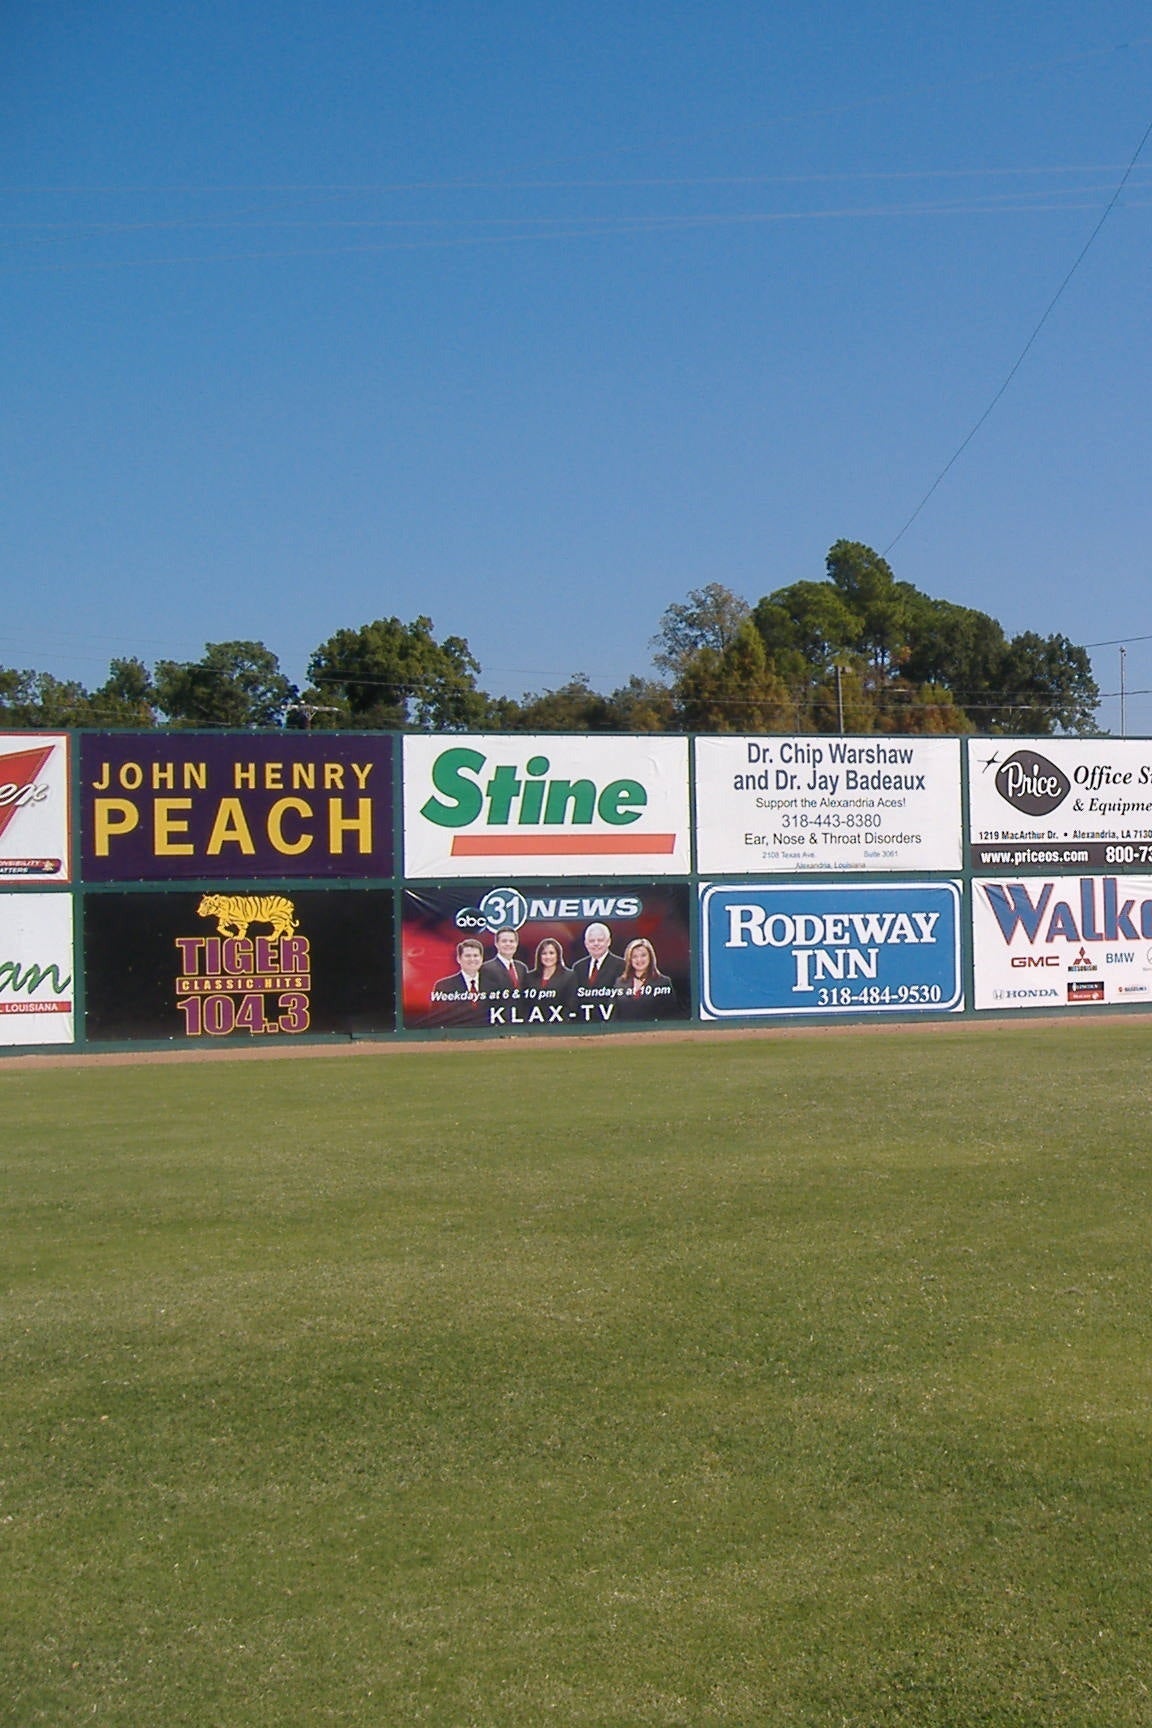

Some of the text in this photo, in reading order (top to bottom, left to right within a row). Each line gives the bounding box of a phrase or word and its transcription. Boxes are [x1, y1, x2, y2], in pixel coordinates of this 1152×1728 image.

[748, 743, 914, 768] Dr. Chip Warshaw
[92, 762, 374, 789] JOHN HENRY
[734, 770, 925, 795] and Dr. Jay Badeaux
[1001, 761, 1061, 797] Price
[1074, 766, 1132, 790] Office
[420, 747, 648, 828] Stine
[756, 798, 906, 810] Support the Alexandria Aces!
[1073, 800, 1084, 811] &
[94, 798, 373, 856] PEACH
[782, 814, 881, 828] 318-443-8380
[744, 832, 922, 846] Ear, Nose & Throat Disorders
[979, 831, 1059, 840] 1219 MacArthur Dr.
[1073, 830, 1119, 840] Alexandria,
[1122, 830, 1131, 839] LA
[981, 849, 1088, 865] www.priceos.com
[456, 896, 640, 927] abc 31 NEWS
[724, 905, 940, 948] RODEWAY
[176, 936, 310, 976] TIGER
[1011, 956, 1060, 967] GMC
[1106, 952, 1135, 963] BMW
[792, 948, 879, 992] INN
[182, 978, 302, 990] CLASSIC HITS
[577, 986, 670, 998] Sundays at 10 pm
[431, 989, 556, 1001] Weekdays at 6 & 10 pm
[818, 985, 941, 1006] 318-484-9530
[1005, 989, 1058, 998] HONDA
[6, 1004, 57, 1012] LOUISIANA
[177, 994, 310, 1035] 104.3
[490, 1004, 614, 1024] KLAX-TV
